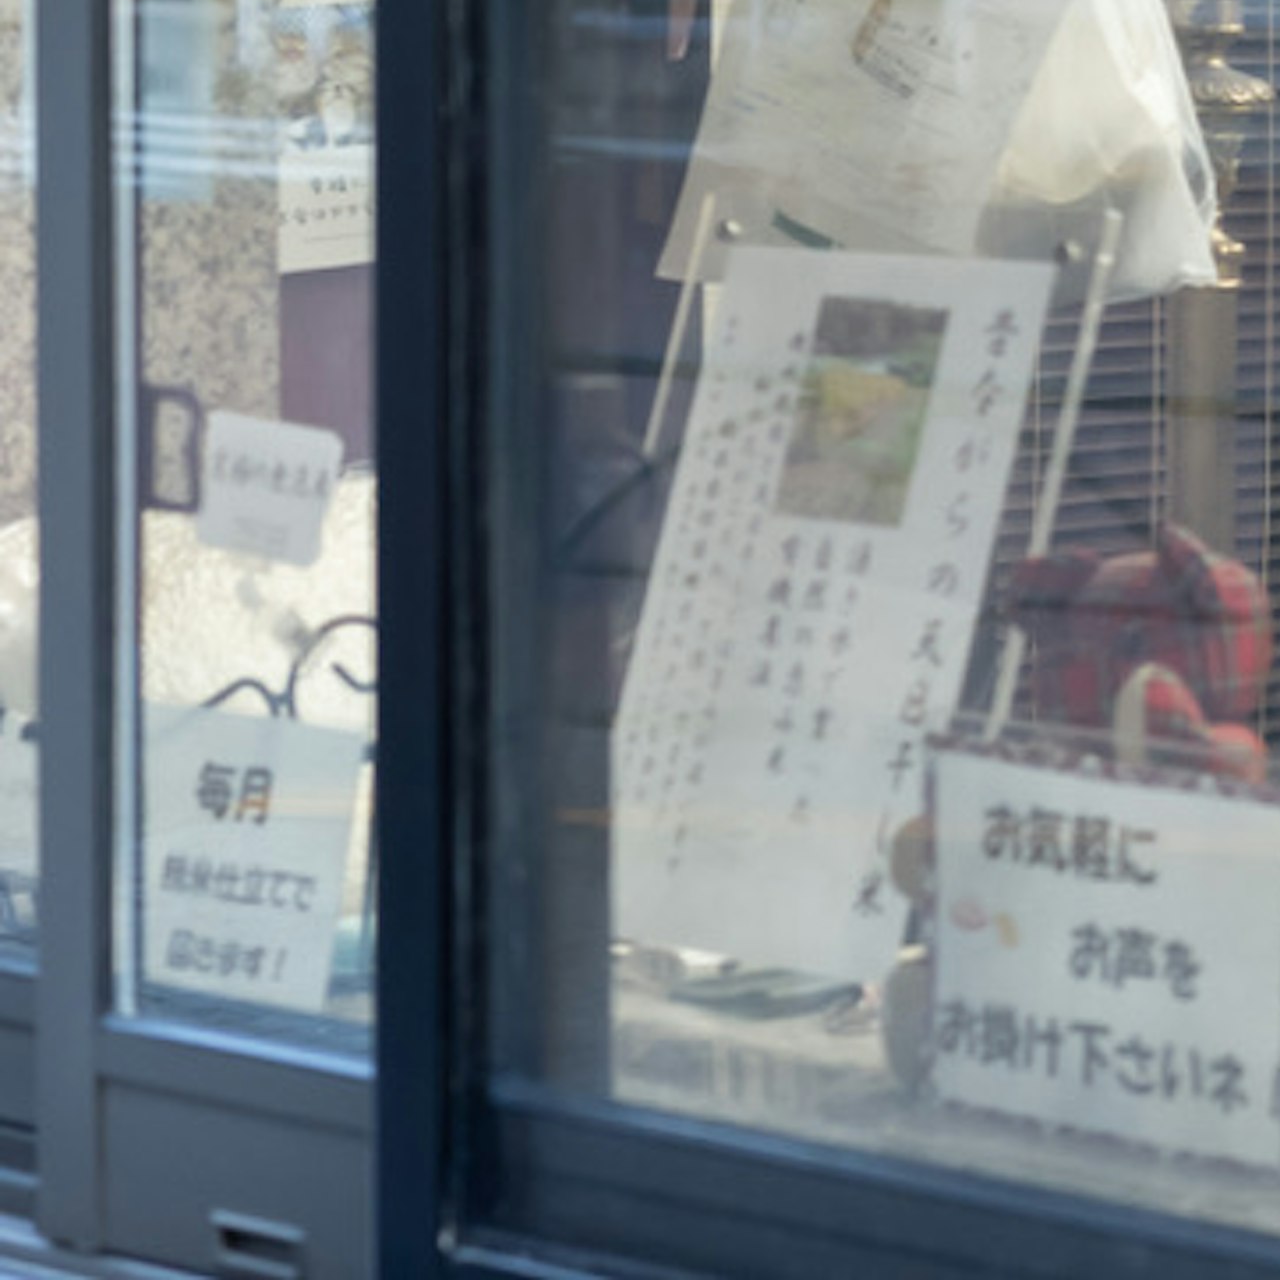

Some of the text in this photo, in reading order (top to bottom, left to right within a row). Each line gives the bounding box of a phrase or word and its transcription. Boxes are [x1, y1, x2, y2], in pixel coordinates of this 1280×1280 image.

[196, 761, 274, 825] 毎月
[983, 806, 1156, 885] お気軽に
[1070, 923, 1200, 1001] お声を
[938, 1000, 1248, 1114] お掛け下さいネ
